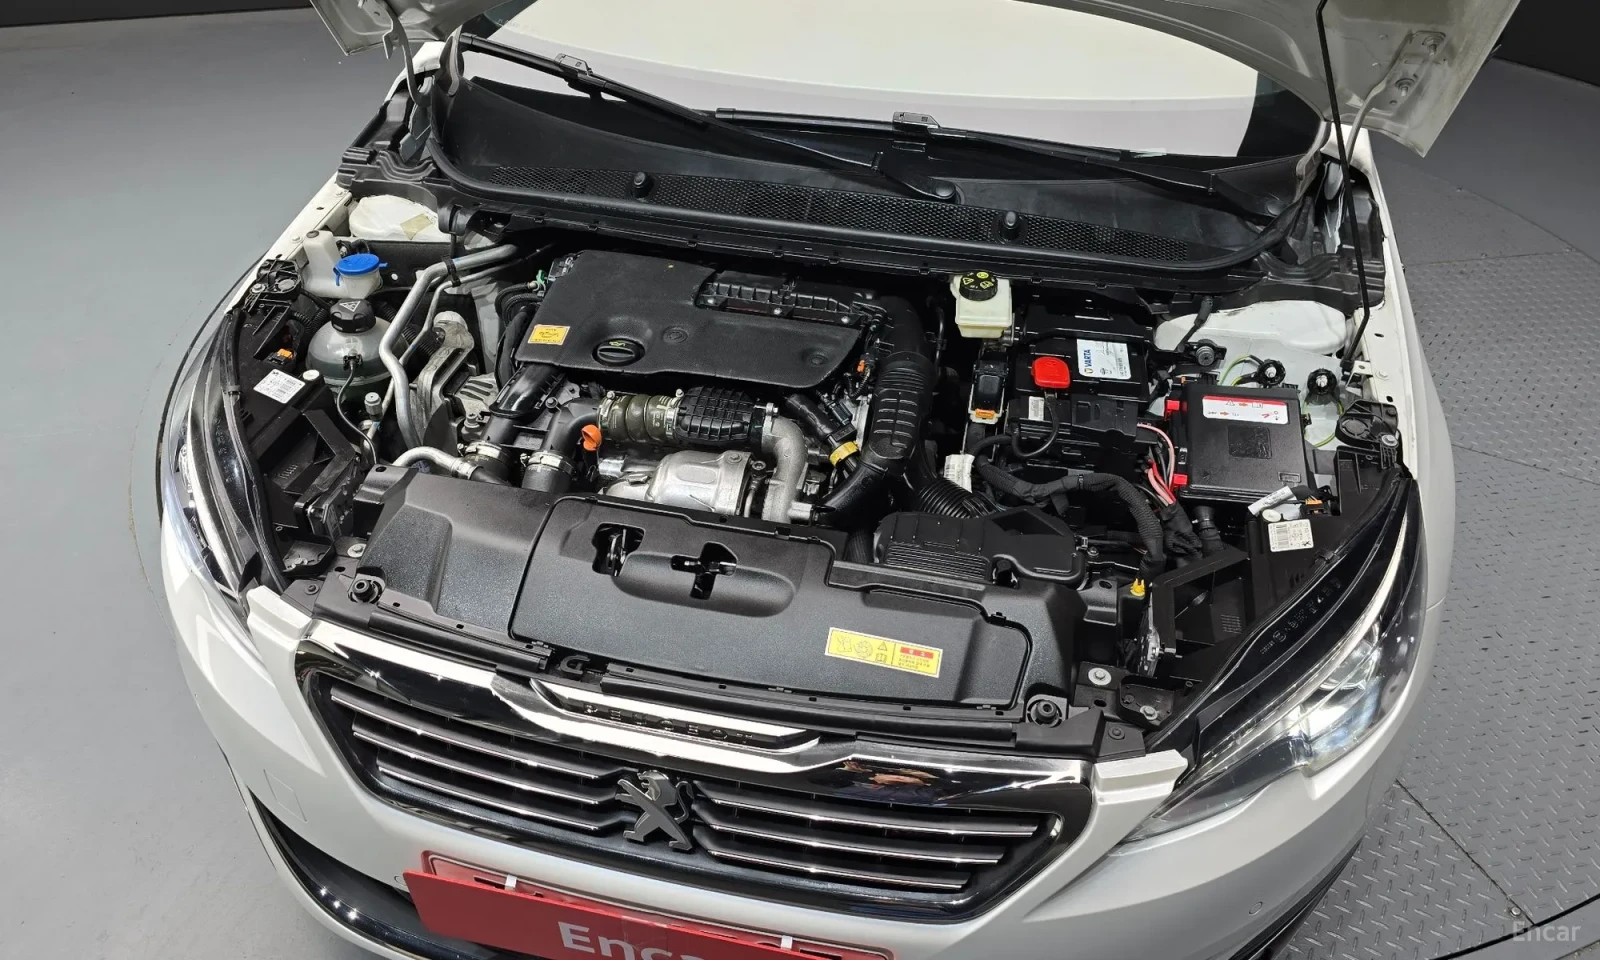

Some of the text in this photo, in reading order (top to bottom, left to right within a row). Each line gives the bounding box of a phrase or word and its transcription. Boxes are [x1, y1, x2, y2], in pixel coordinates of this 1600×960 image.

[1083, 349, 1092, 368] VARTA
[583, 703, 753, 744] PEUGEOT
[557, 921, 706, 960] Enc
